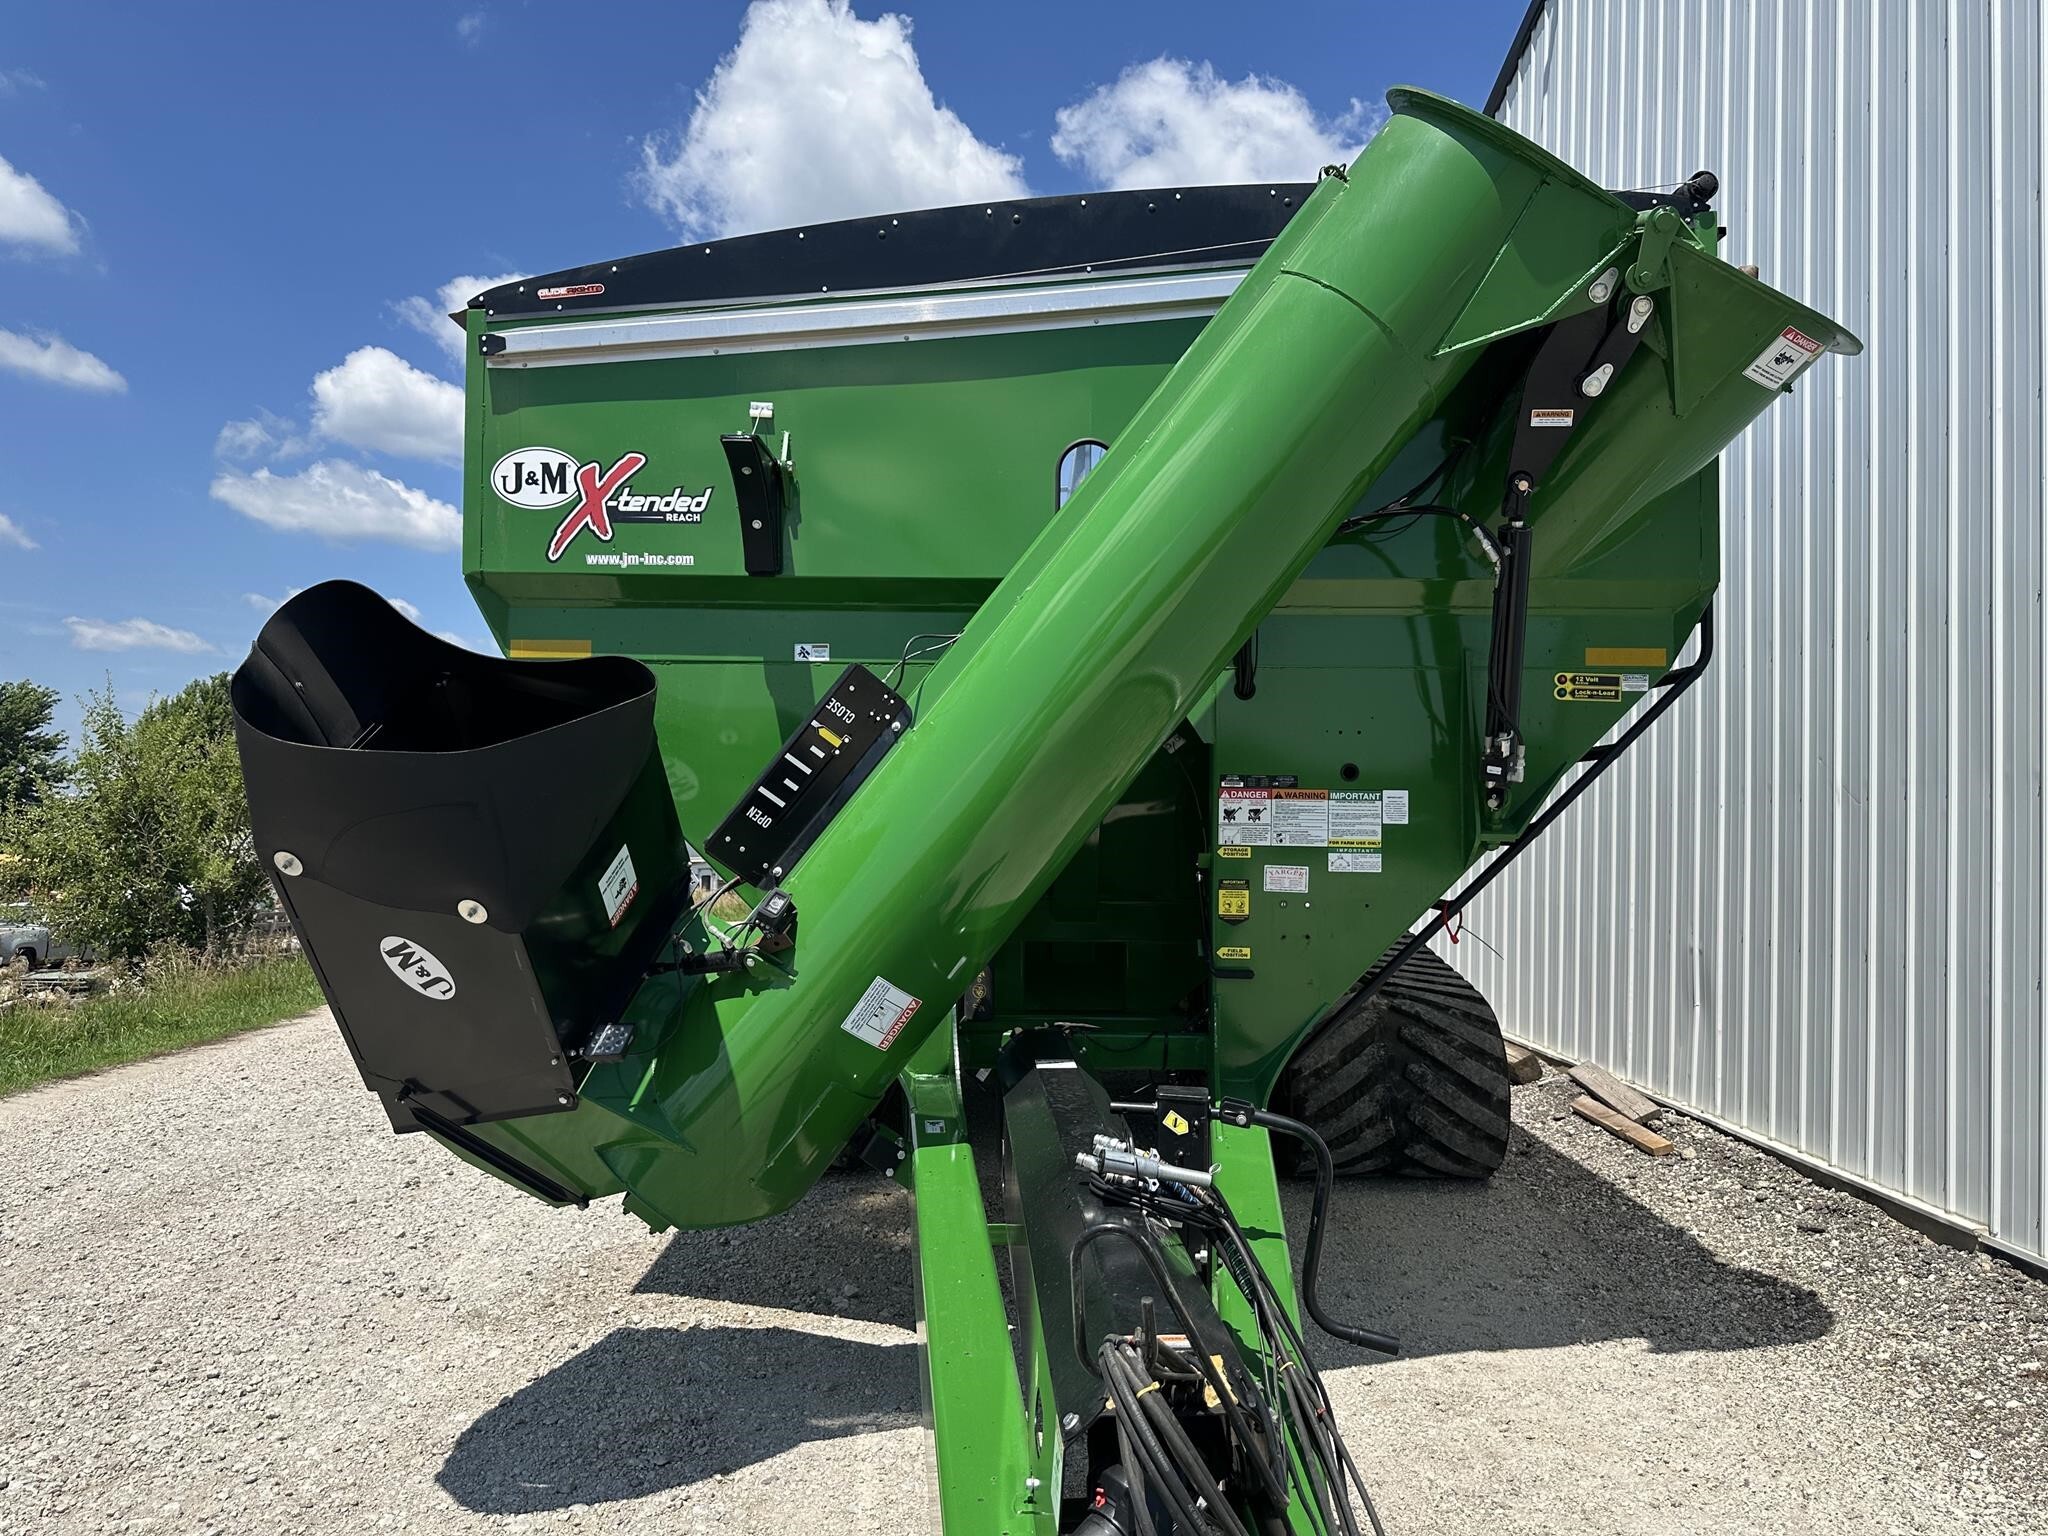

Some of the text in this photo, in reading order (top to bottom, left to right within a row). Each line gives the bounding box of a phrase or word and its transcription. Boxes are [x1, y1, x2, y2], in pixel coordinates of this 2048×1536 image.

[1793, 333, 1818, 351] DANGER
[501, 462, 570, 494] J&M
[666, 513, 701, 522] REACH
[586, 553, 694, 567] www.jm-inc.com
[825, 697, 856, 724] CLOSE
[1230, 791, 1267, 799] DANGER
[1330, 792, 1381, 800] IMPORTANT
[746, 805, 772, 829] OPEN
[383, 941, 453, 996] J&M
[880, 1009, 912, 1048] DANGER
